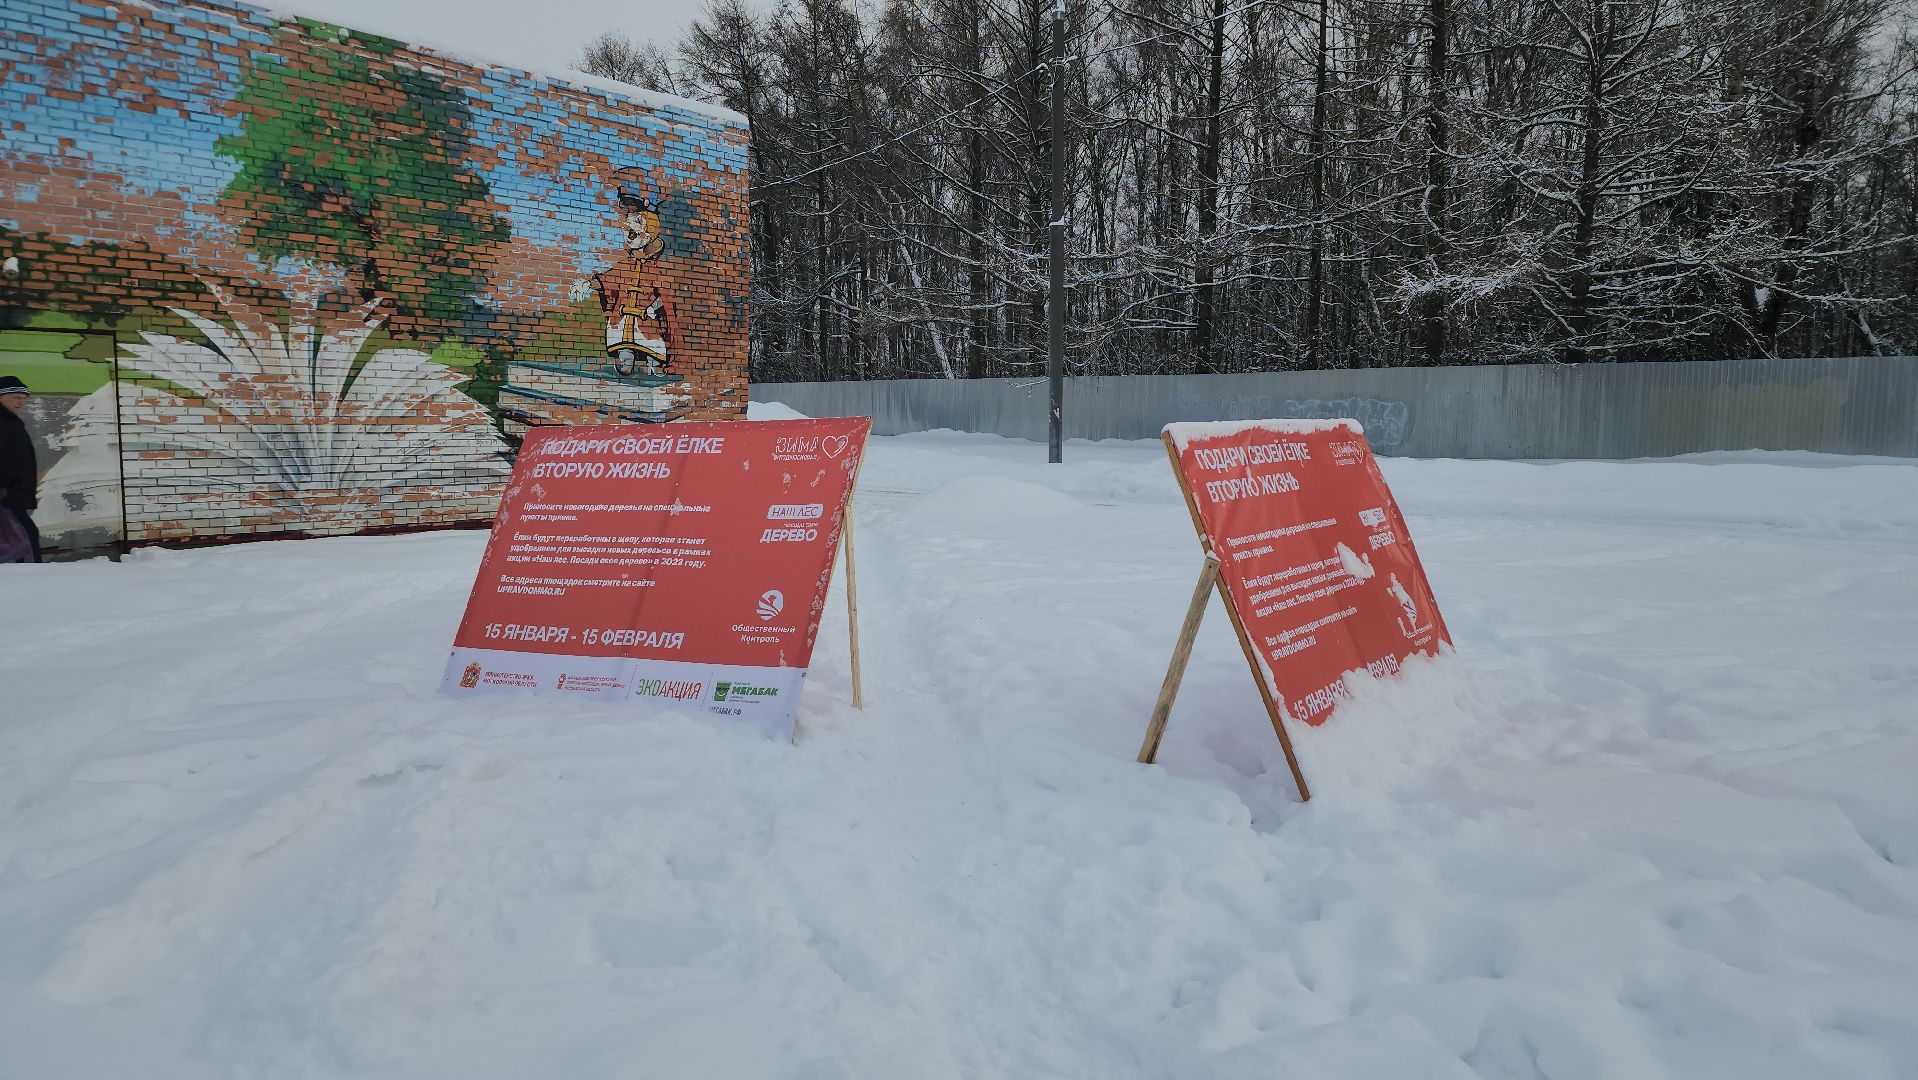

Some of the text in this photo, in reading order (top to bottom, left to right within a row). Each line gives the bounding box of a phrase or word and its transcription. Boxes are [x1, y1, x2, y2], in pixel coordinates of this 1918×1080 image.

[540, 435, 725, 458] ПОДАРИ СВОЕЙ ЁЛКЕ
[775, 436, 819, 453] ЗИМА
[1193, 446, 1250, 474] ПОДАРИ
[1248, 439, 1288, 466] СВОЕЙ
[1282, 438, 1312, 462] ЁЛКЕ
[533, 462, 671, 479] ВТОРУЮ ЖИЗНЬ
[1206, 471, 1300, 503] ВТОРУЮ ЖИЗНЬ
[654, 503, 711, 513] спецльные
[772, 506, 819, 518] НАШ ЛЕС
[513, 531, 532, 541] Ёлки
[532, 533, 556, 543] будут
[556, 534, 611, 543] переработаны
[641, 536, 676, 545] которая
[677, 537, 706, 545] станет
[760, 528, 818, 544] ДЕРЕВО
[500, 574, 514, 583] Все
[515, 576, 542, 584] адреса
[543, 577, 583, 587] площадок
[583, 579, 620, 587] смотрите
[631, 579, 656, 587] сайте
[484, 623, 502, 639] 15
[502, 623, 569, 643] ЯНВАРЯ
[582, 628, 600, 645] 15
[600, 628, 685, 650] ФЕВРАЛЯ
[731, 623, 797, 634] Общественный
[740, 634, 780, 644] Контроль
[636, 678, 702, 701] ЭКОАКЦИЯ
[732, 686, 779, 697] МЕГАБАК
[710, 706, 742, 716] ЕГАБАК.РФ
[1293, 697, 1309, 721] 15
